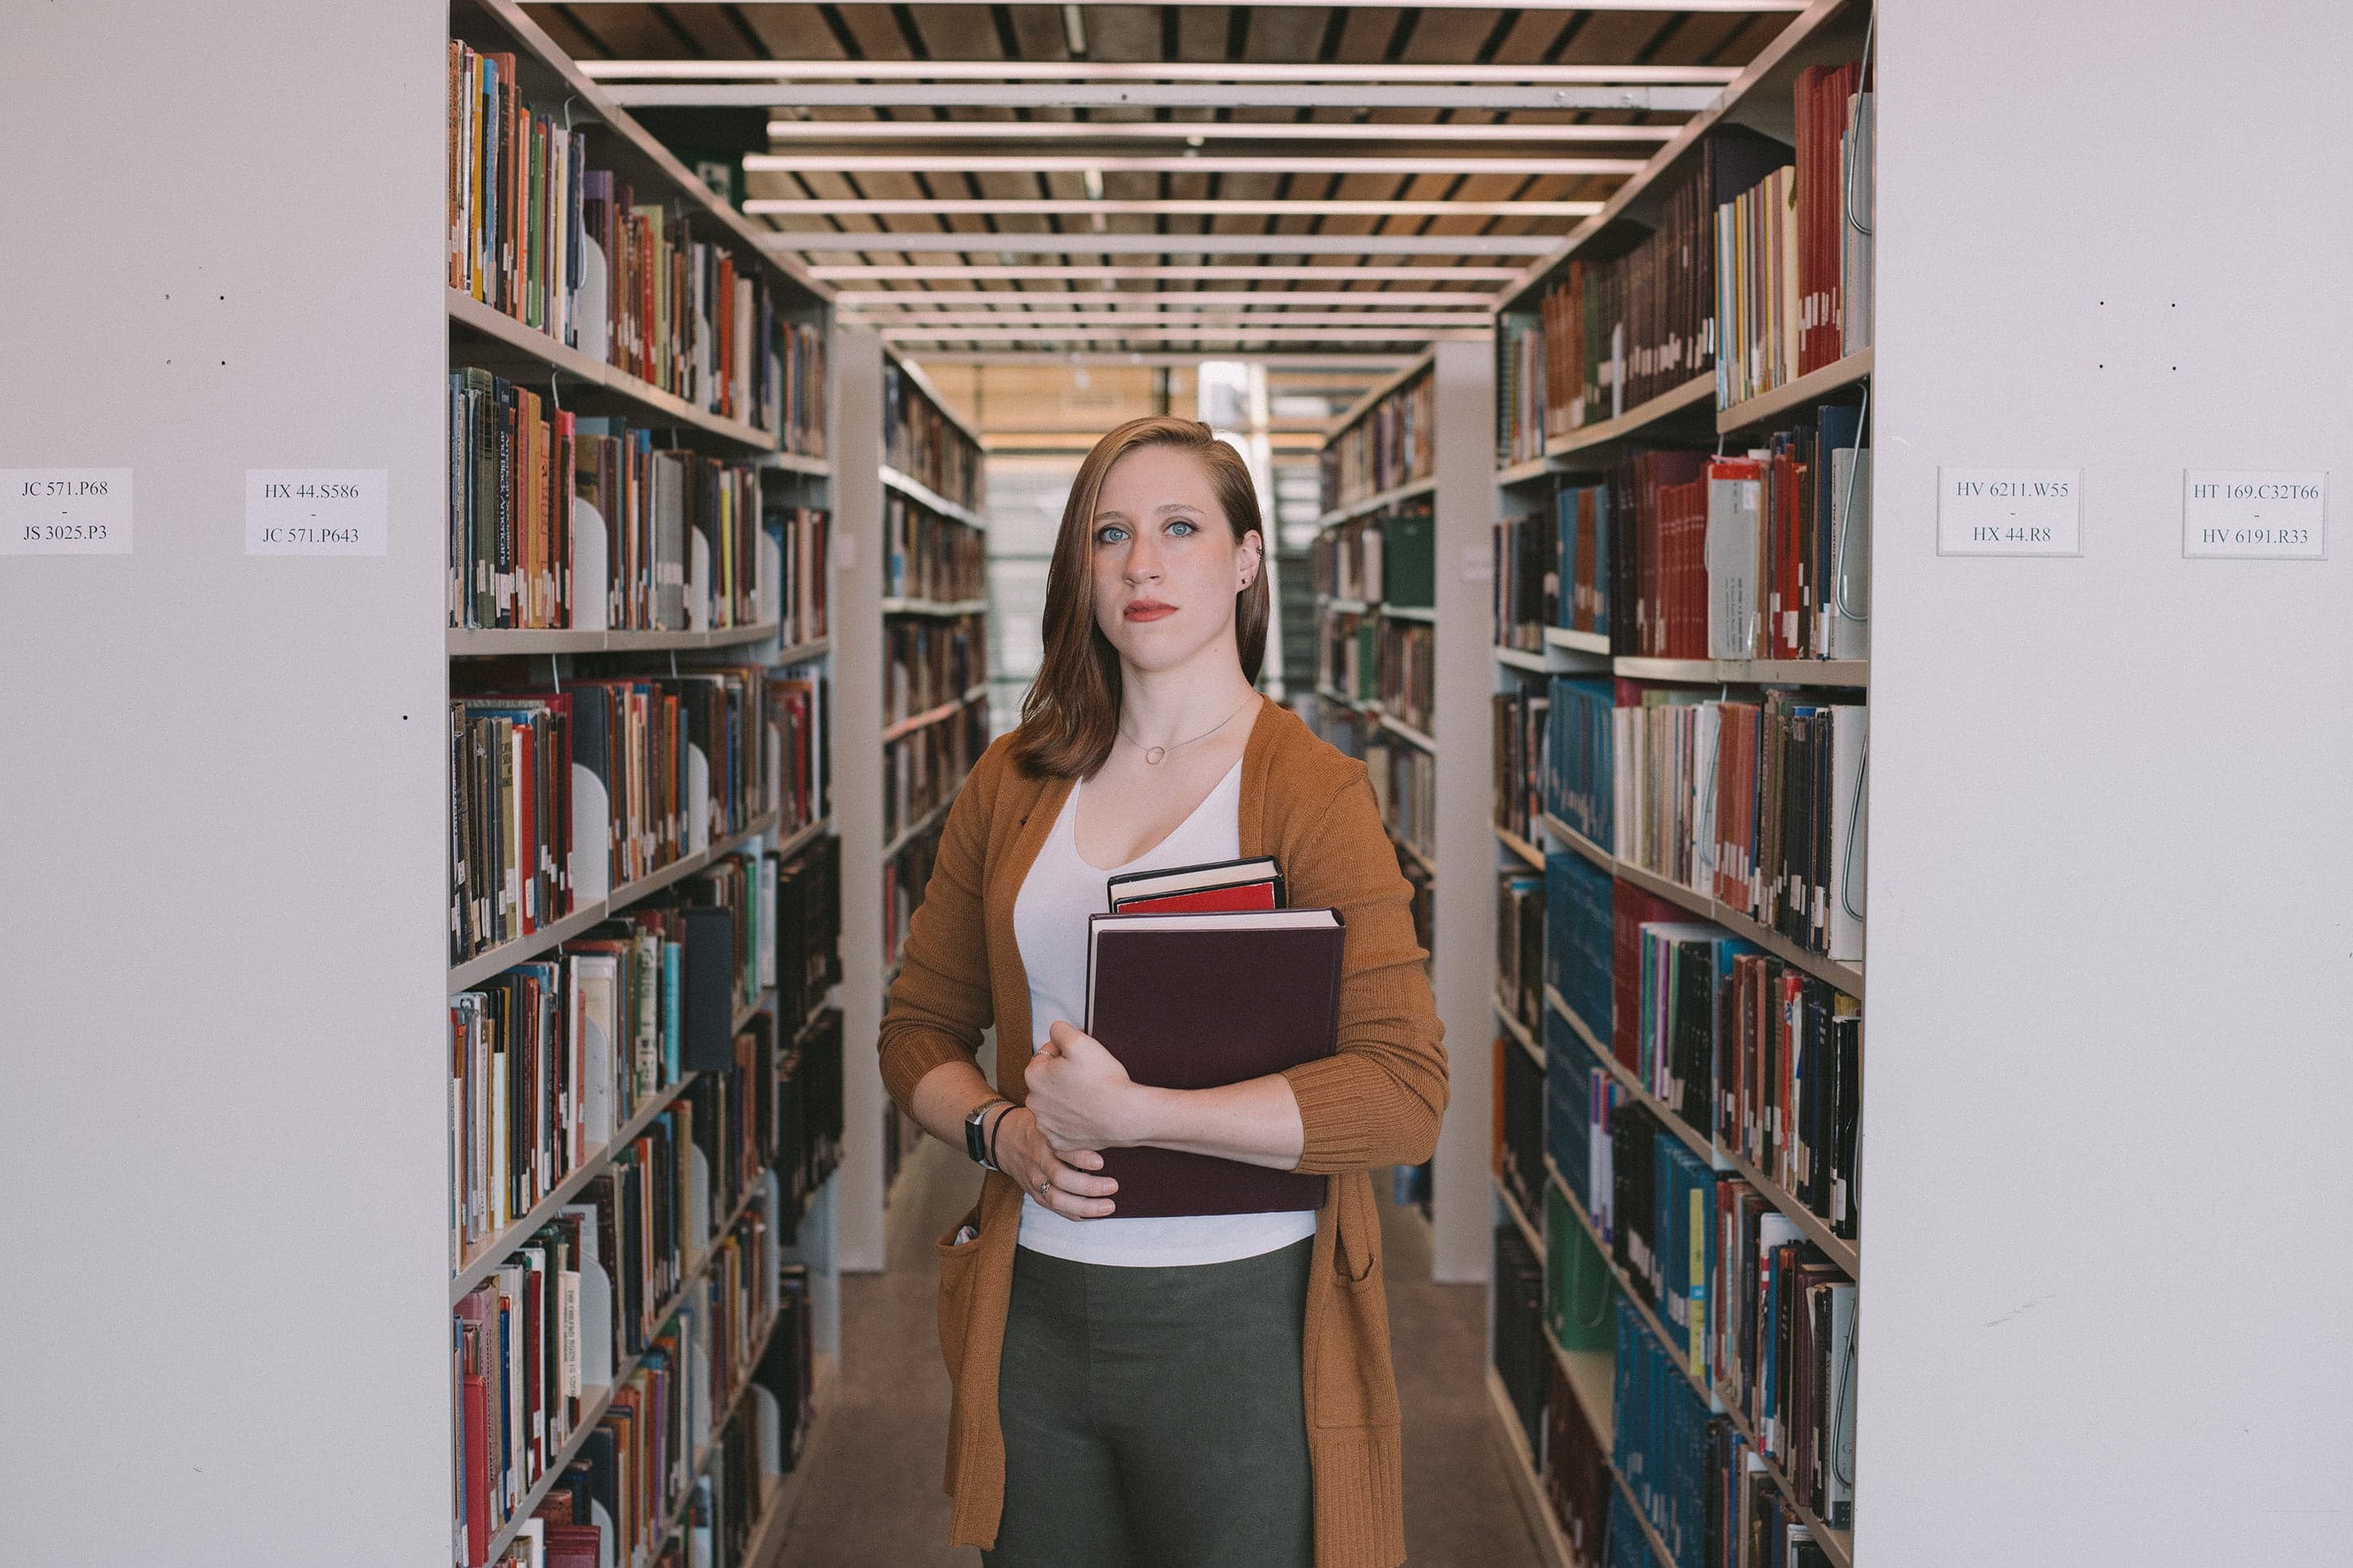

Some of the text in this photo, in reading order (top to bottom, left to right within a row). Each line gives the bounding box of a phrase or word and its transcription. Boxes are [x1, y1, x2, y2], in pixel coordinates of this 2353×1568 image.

[22, 480, 108, 496] JC 571.P68
[265, 483, 359, 499] HX 44.S586
[1956, 482, 2068, 497] HV 6211.W55
[2193, 483, 2319, 500] HT 169.C32T66
[23, 525, 107, 541] JS 3025.P3
[262, 527, 359, 543] JC 571.P643
[1973, 526, 2051, 542] HX 44.R8
[2203, 528, 2308, 544] HV 6191.R33
